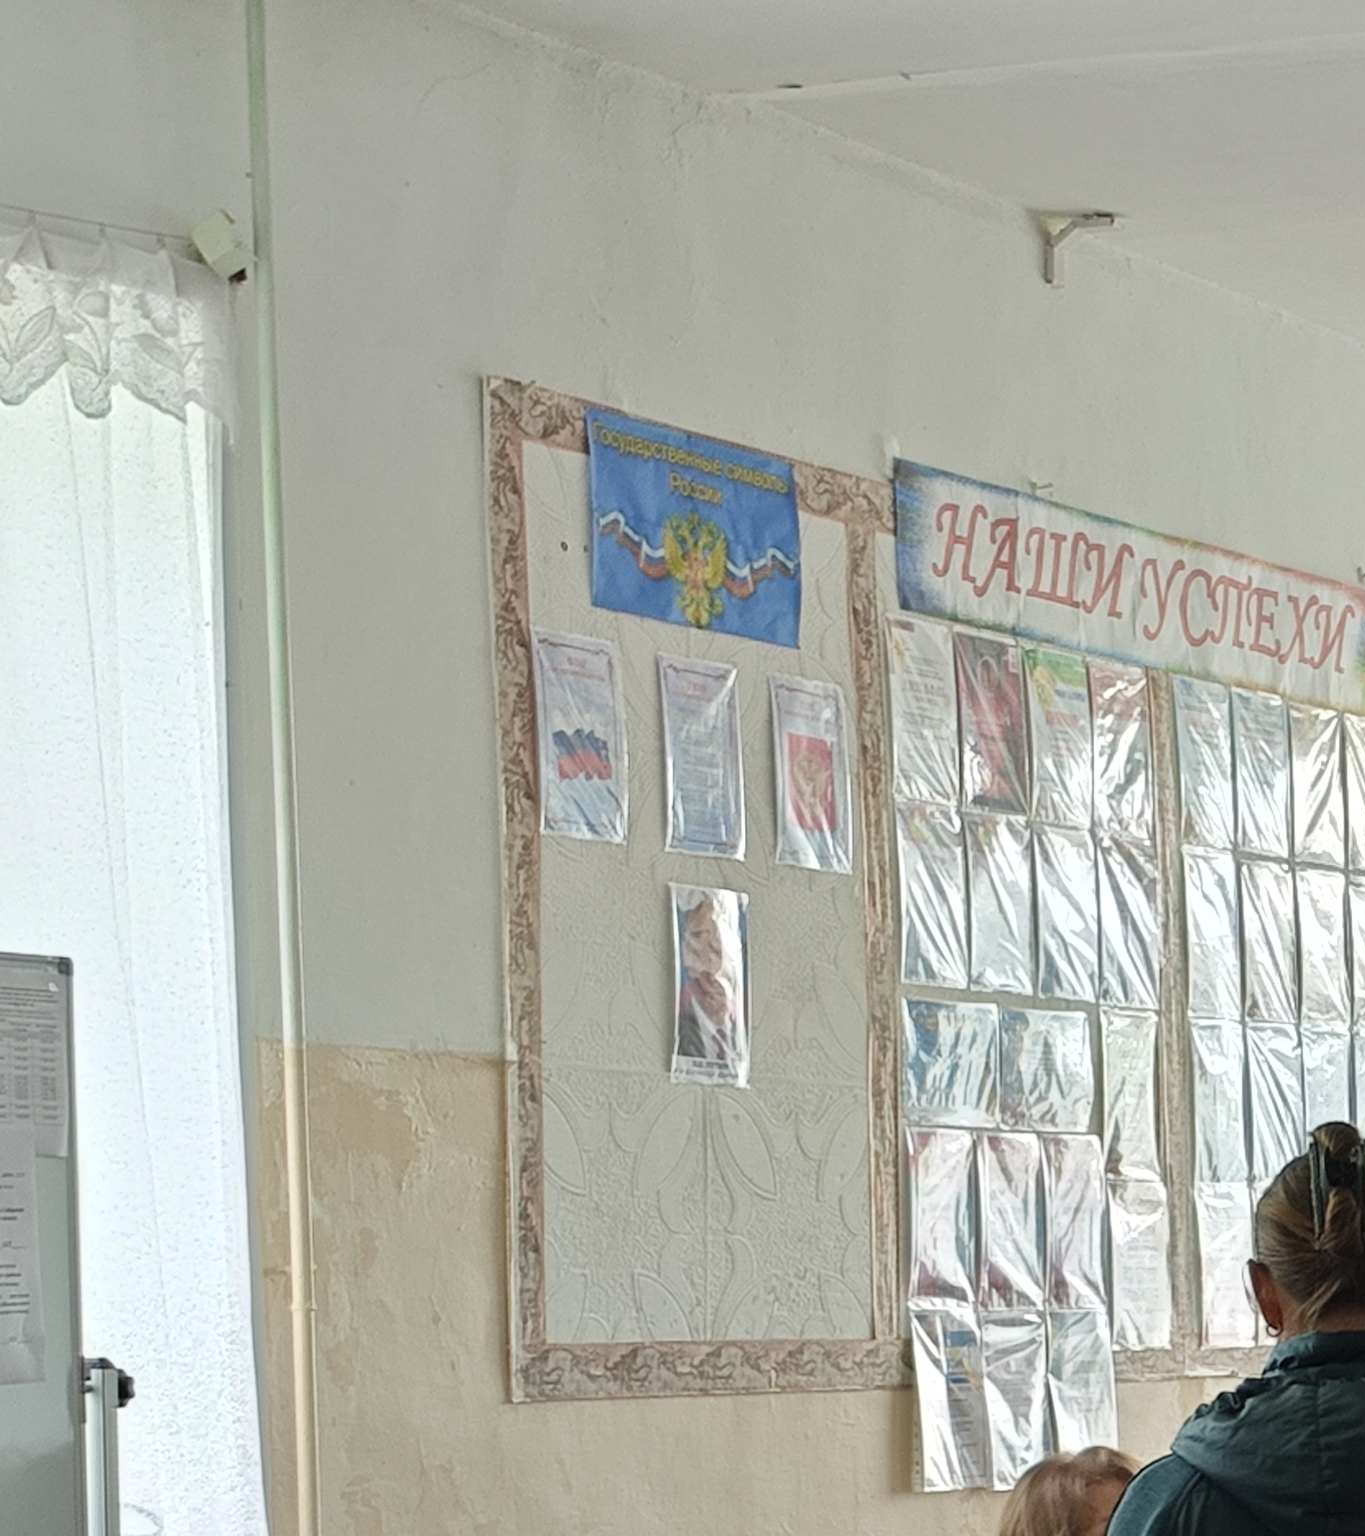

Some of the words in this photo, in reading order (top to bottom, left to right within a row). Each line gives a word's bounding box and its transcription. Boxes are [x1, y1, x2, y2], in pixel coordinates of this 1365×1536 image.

[594, 421, 722, 475] Государственные
[669, 473, 723, 504] России
[932, 502, 1135, 621] НАШИ
[1140, 558, 1357, 673] УСПЕХИ
